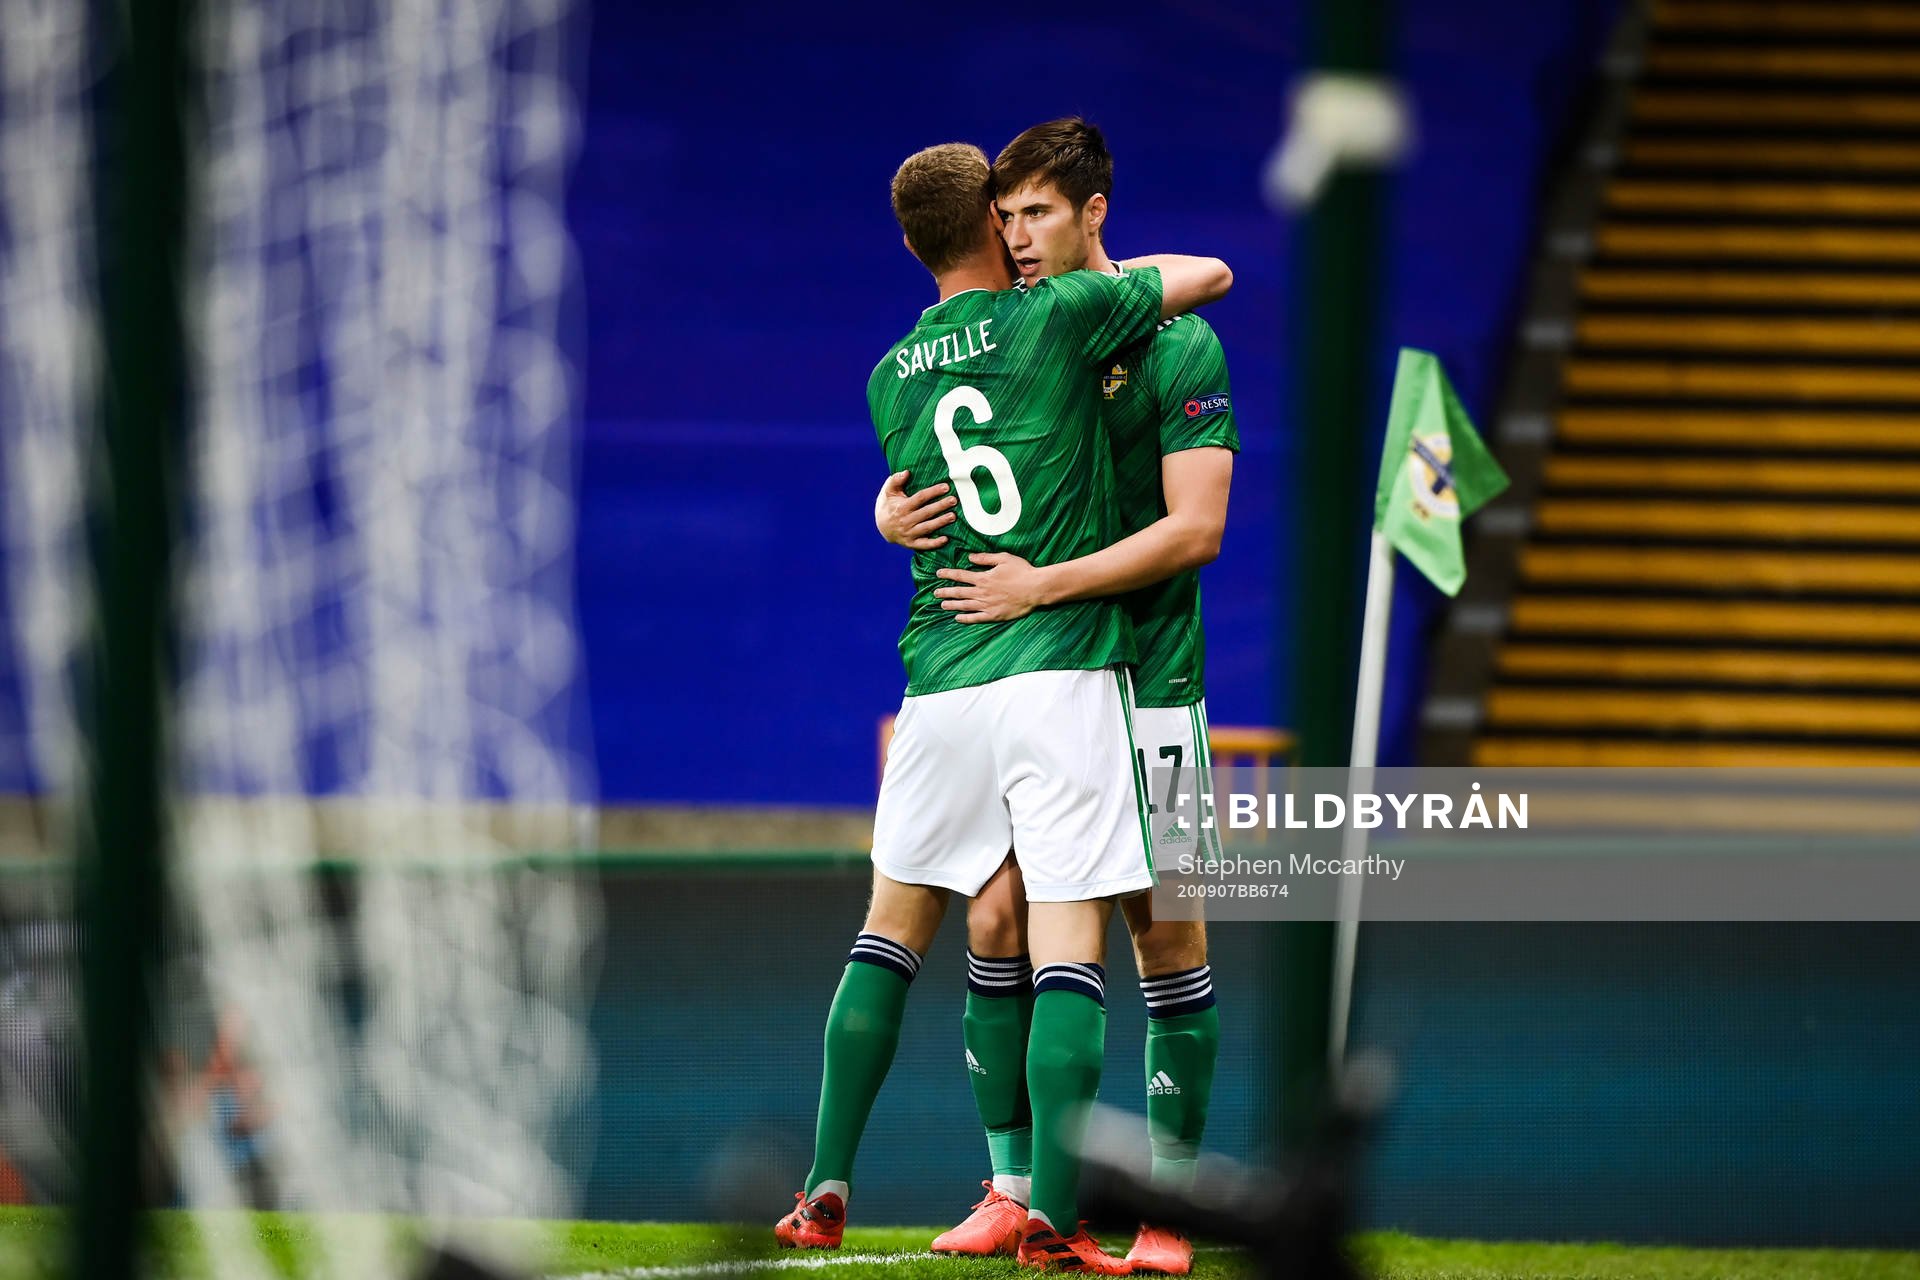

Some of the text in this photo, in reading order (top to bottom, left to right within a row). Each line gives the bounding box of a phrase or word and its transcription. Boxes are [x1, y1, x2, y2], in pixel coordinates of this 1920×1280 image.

[896, 318, 997, 379] SAVILLE
[933, 385, 1022, 536] 6
[1159, 835, 1193, 845] adidas
